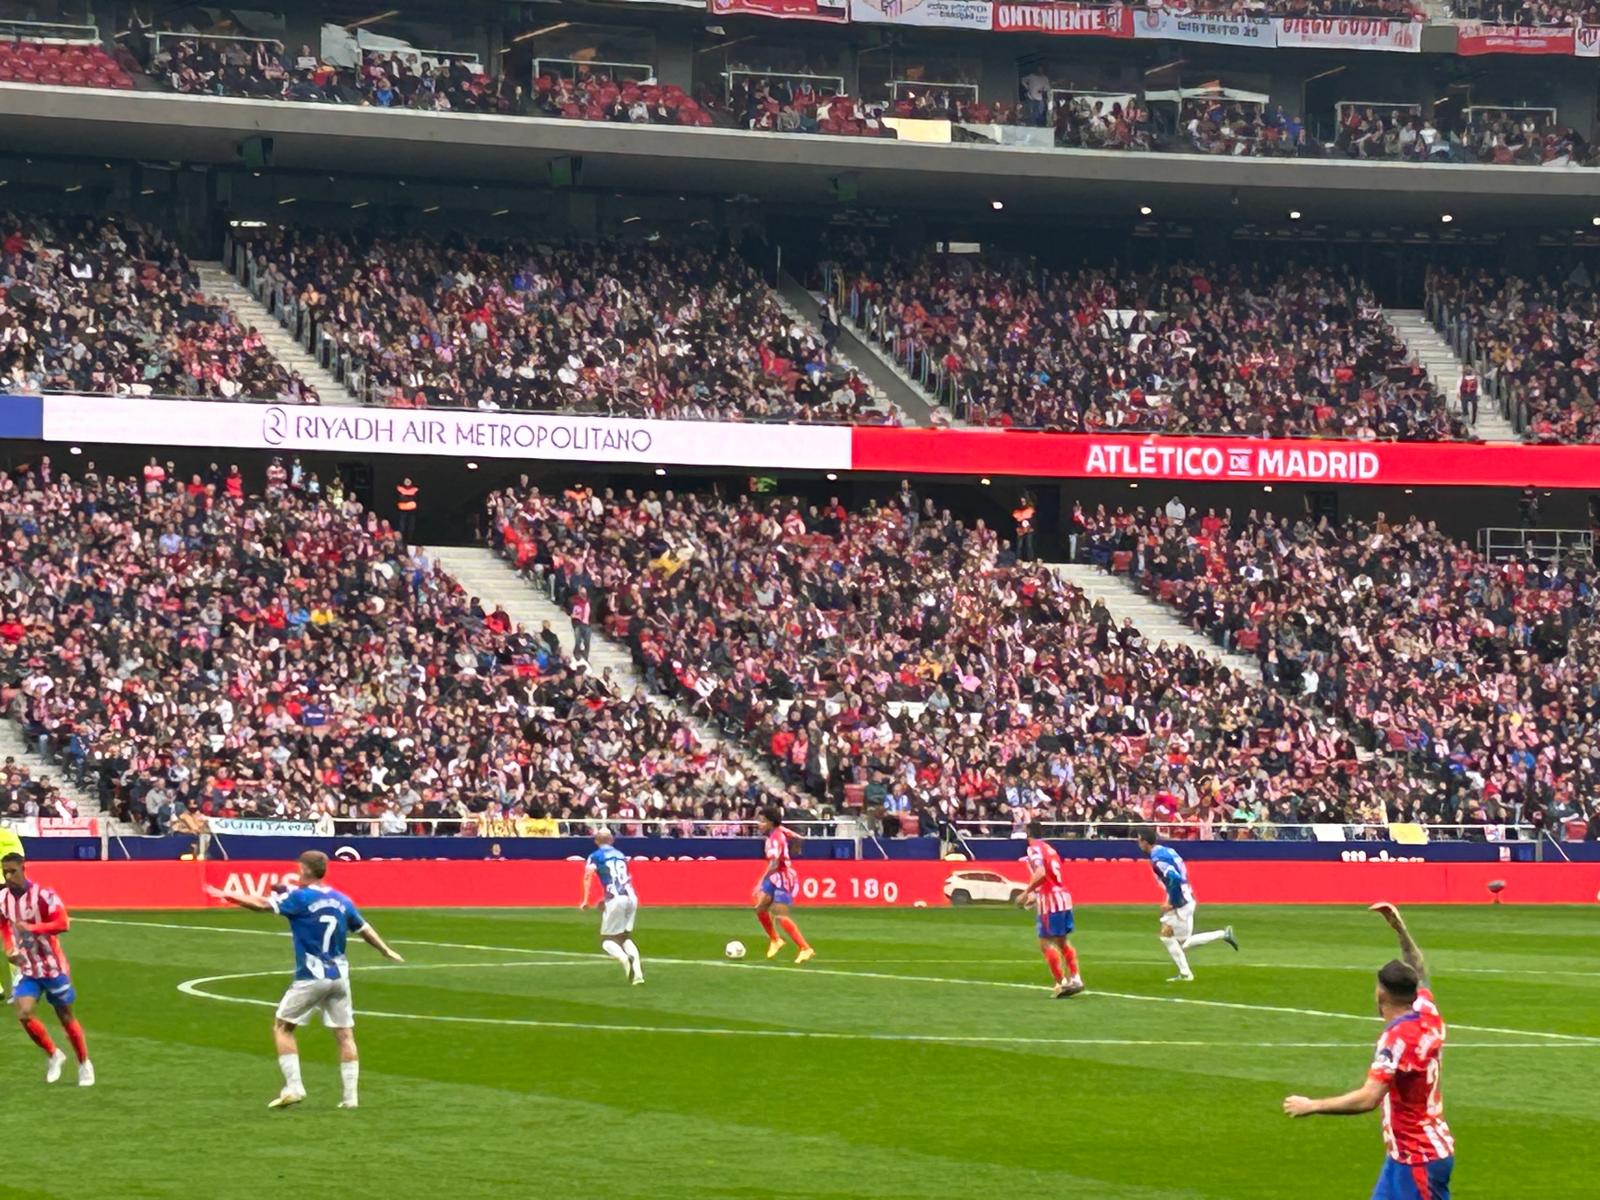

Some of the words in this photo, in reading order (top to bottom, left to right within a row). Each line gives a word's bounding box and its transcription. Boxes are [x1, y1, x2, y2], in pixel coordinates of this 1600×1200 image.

[296, 415, 394, 443] RIYADH
[402, 421, 447, 445] AIR
[455, 422, 652, 453] METROPOLITANO
[1085, 440, 1224, 475] ATLÉTICO
[1257, 448, 1380, 479] MADRID
[319, 914, 338, 954] 7
